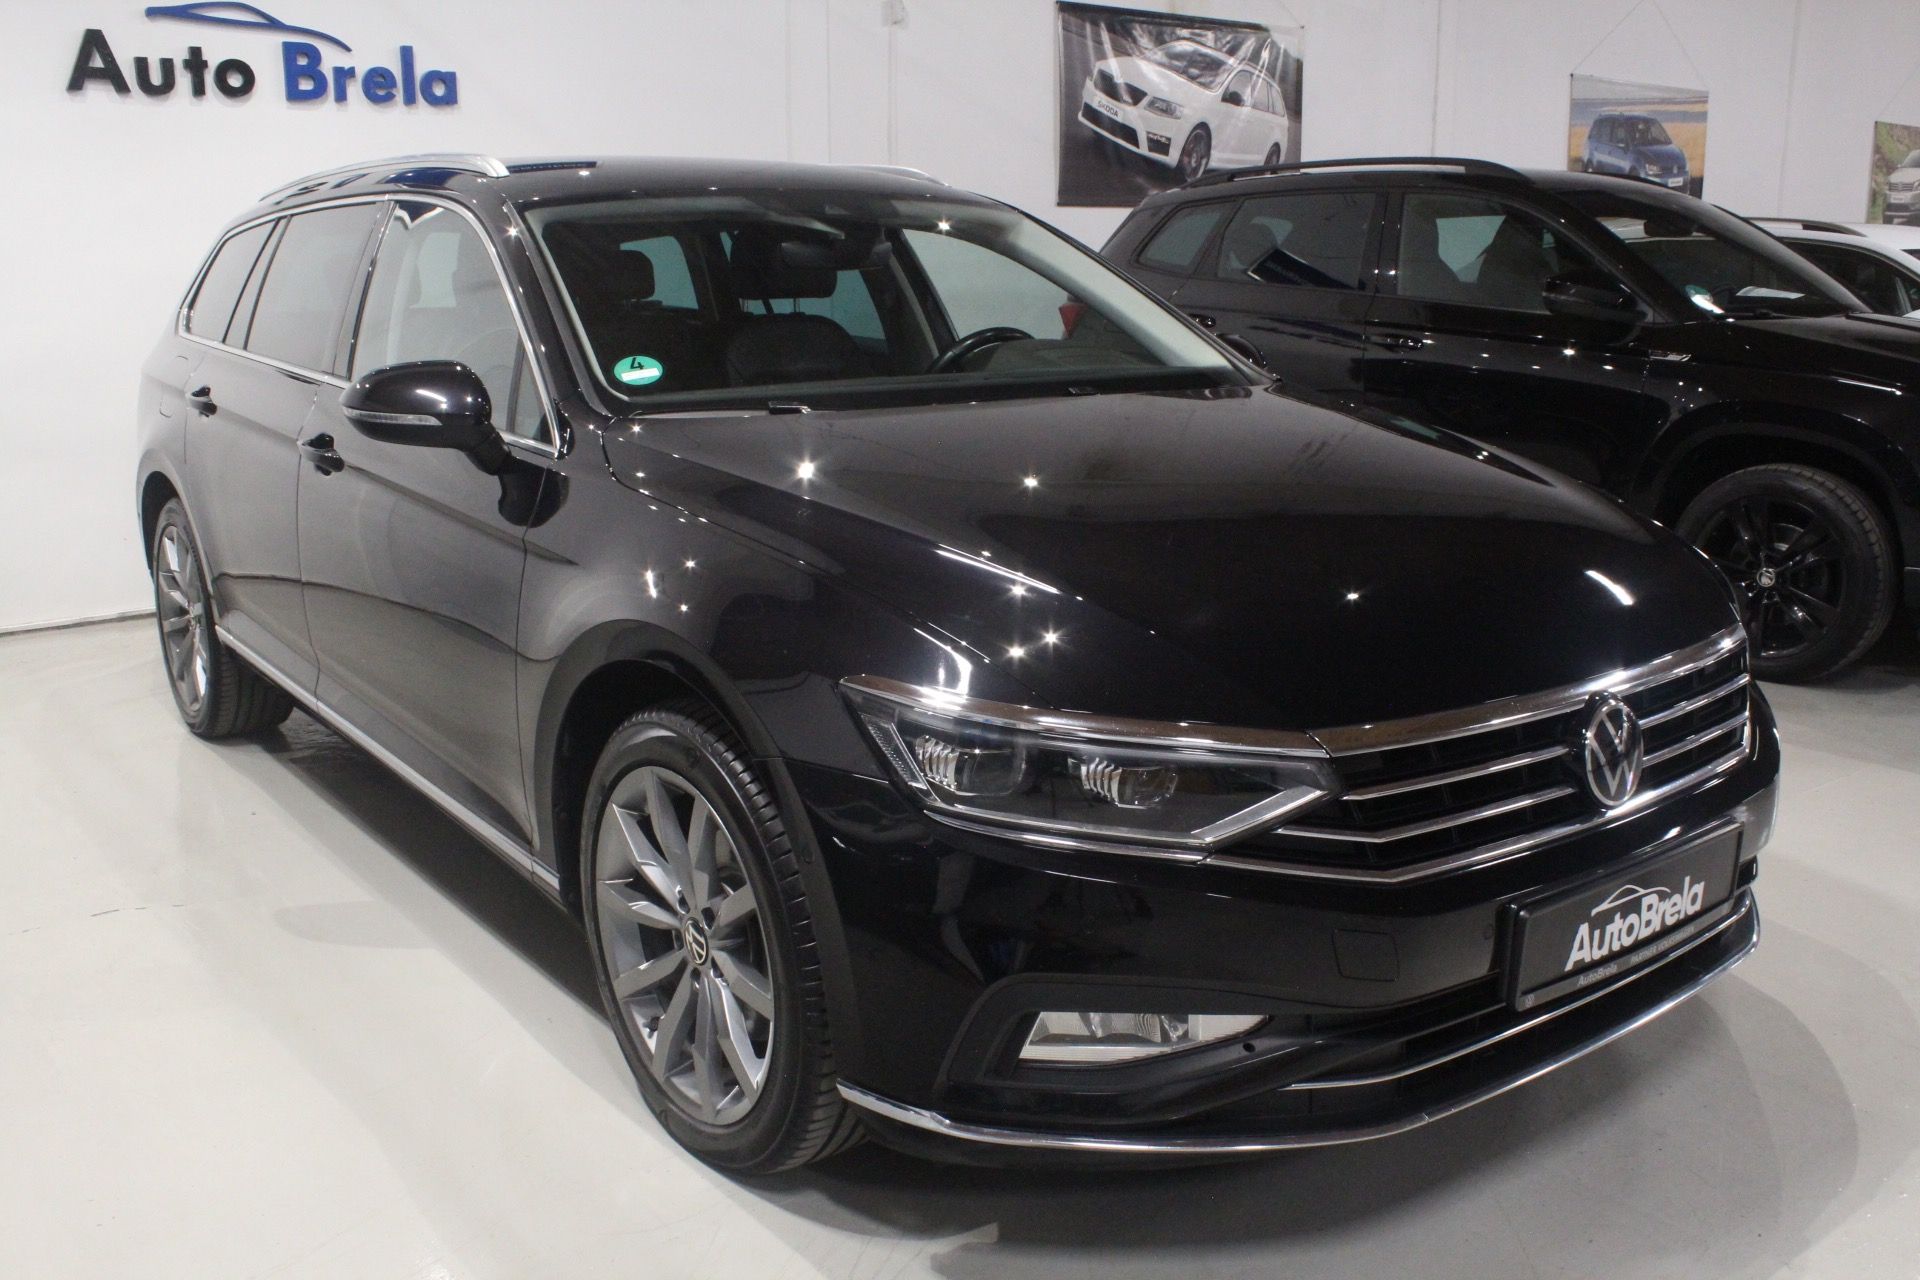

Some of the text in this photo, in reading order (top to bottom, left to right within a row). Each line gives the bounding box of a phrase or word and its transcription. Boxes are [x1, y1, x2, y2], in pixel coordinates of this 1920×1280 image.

[66, 28, 459, 106] Auto Brela
[630, 356, 645, 370] 4
[1564, 875, 1706, 972] AutoBrela
